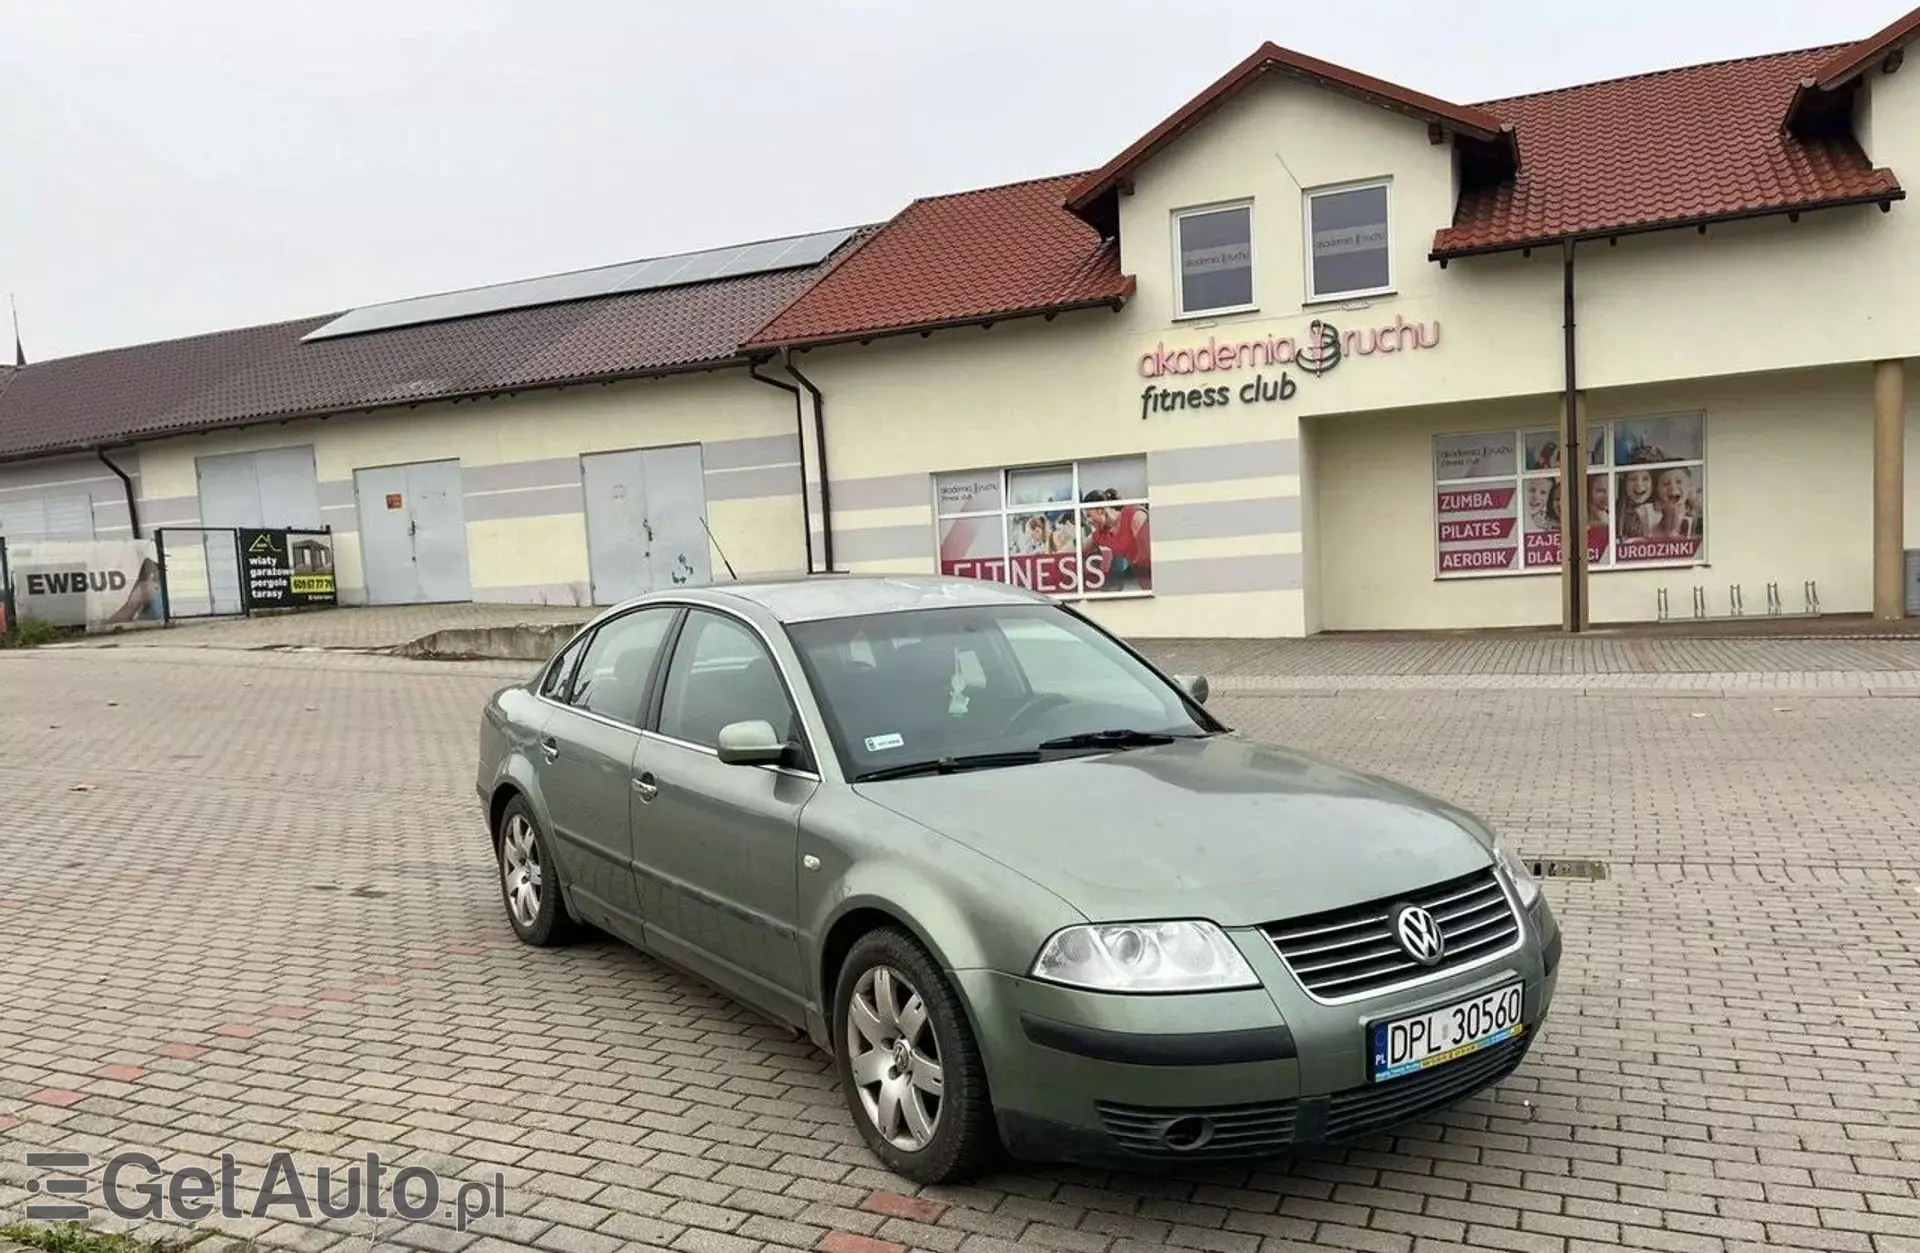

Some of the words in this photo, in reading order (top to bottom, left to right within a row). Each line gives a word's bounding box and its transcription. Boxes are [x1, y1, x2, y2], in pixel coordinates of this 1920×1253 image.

[1138, 334, 1296, 377] akademia
[1341, 315, 1440, 357] ruchu
[1141, 384, 1230, 420] fitness
[1239, 372, 1297, 405] club
[1441, 492, 1492, 510] ZUMBA
[1441, 522, 1501, 539] PILATES
[1527, 534, 1562, 548] ZAJE
[1528, 551, 1554, 564] DLA
[1618, 542, 1694, 559] URODZINKI
[249, 556, 277, 567] wiaty
[1442, 551, 1507, 568] AEROBIK
[27, 570, 126, 595] EWBUD
[250, 578, 288, 589] pergole
[251, 589, 283, 600] tarasy
[1391, 1016, 1441, 1065] DPL
[1452, 988, 1521, 1045] 30560
[1375, 1053, 1386, 1066] PL
